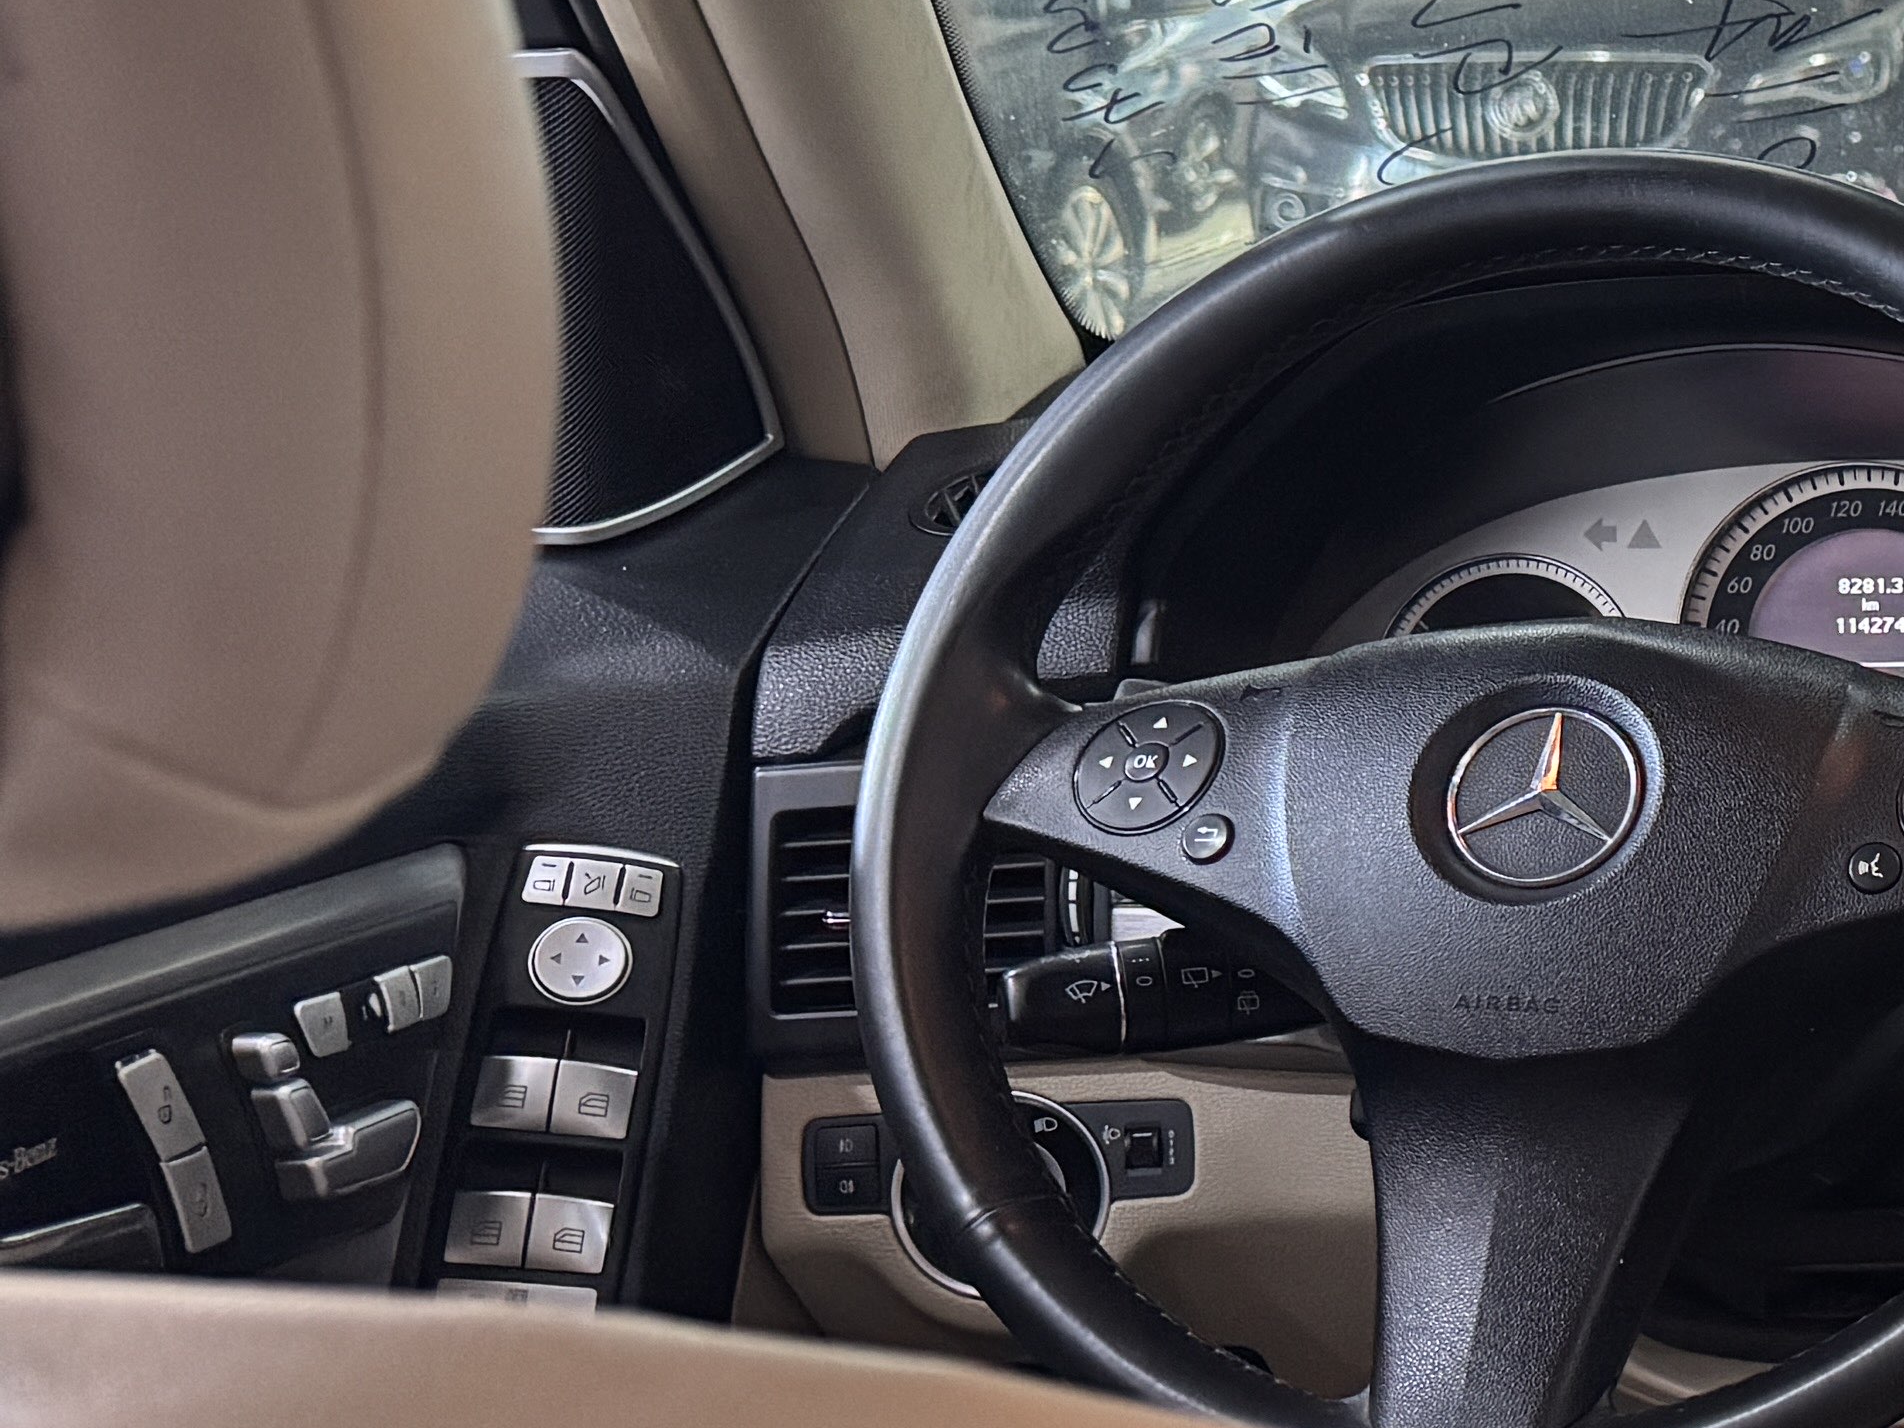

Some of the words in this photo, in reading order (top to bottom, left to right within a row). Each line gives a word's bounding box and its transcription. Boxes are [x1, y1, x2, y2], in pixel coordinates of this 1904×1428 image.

[1830, 500, 1862, 518] 120
[1782, 517, 1815, 535] 100
[1750, 544, 1776, 562] 80
[1727, 576, 1753, 594] 60
[1837, 577, 1904, 595] 8281.3
[1861, 598, 1880, 612] km
[1715, 618, 1740, 636] 40
[1133, 754, 1159, 769] OK
[1453, 993, 1561, 1013] AIRBAG
